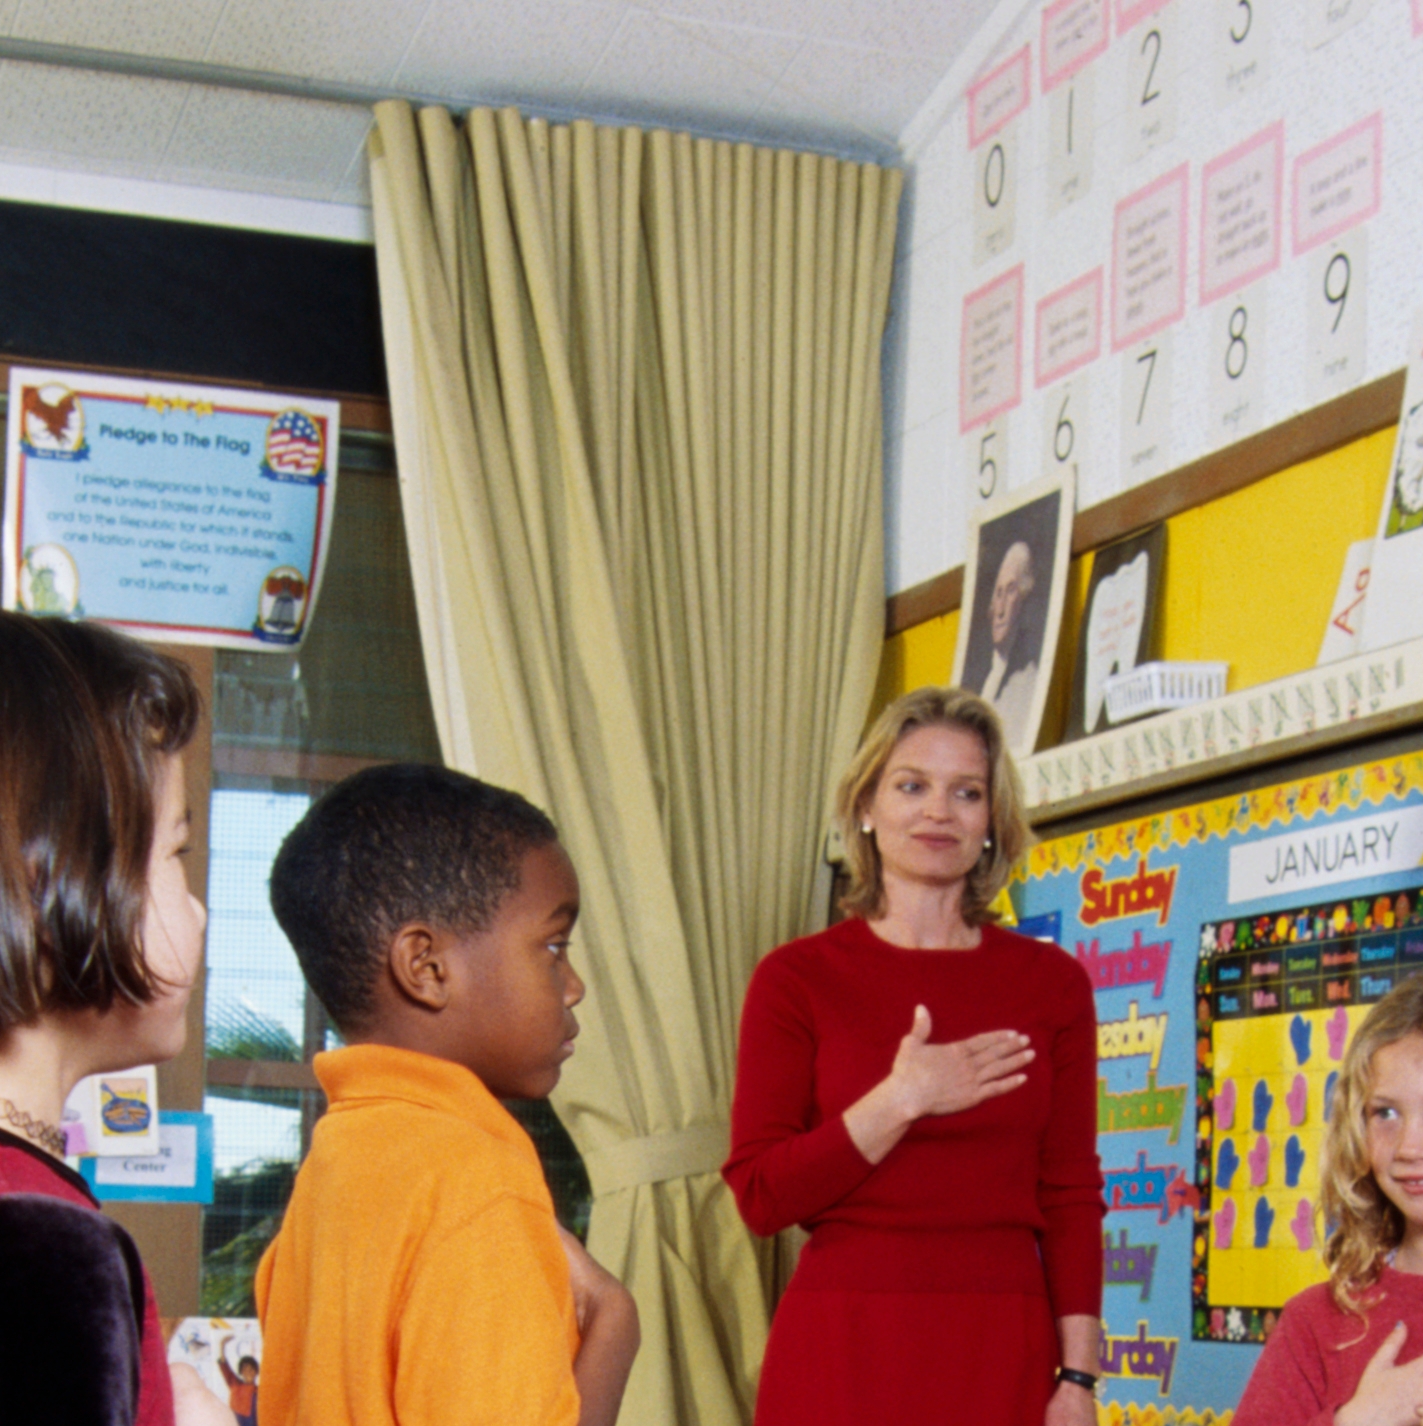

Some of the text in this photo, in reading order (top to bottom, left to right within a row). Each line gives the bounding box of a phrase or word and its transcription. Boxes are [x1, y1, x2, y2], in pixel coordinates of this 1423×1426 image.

[1140, 29, 1162, 106] 2
[1066, 87, 1074, 155] 1
[984, 143, 1005, 208] 0
[1323, 252, 1351, 335] 9
[1224, 305, 1248, 380] 8
[1136, 348, 1158, 426] 7
[99, 423, 251, 456] Pledge to The Flag
[1053, 395, 1075, 462] 6
[82, 474, 130, 490] pledge
[222, 485, 242, 499] the
[246, 487, 271, 503] flag
[978, 432, 998, 500] 5
[1265, 820, 1400, 885] JANUARY
[1078, 859, 1180, 928] Sunday
[1076, 928, 1173, 1000] Monday
[121, 1159, 167, 1174] Center
